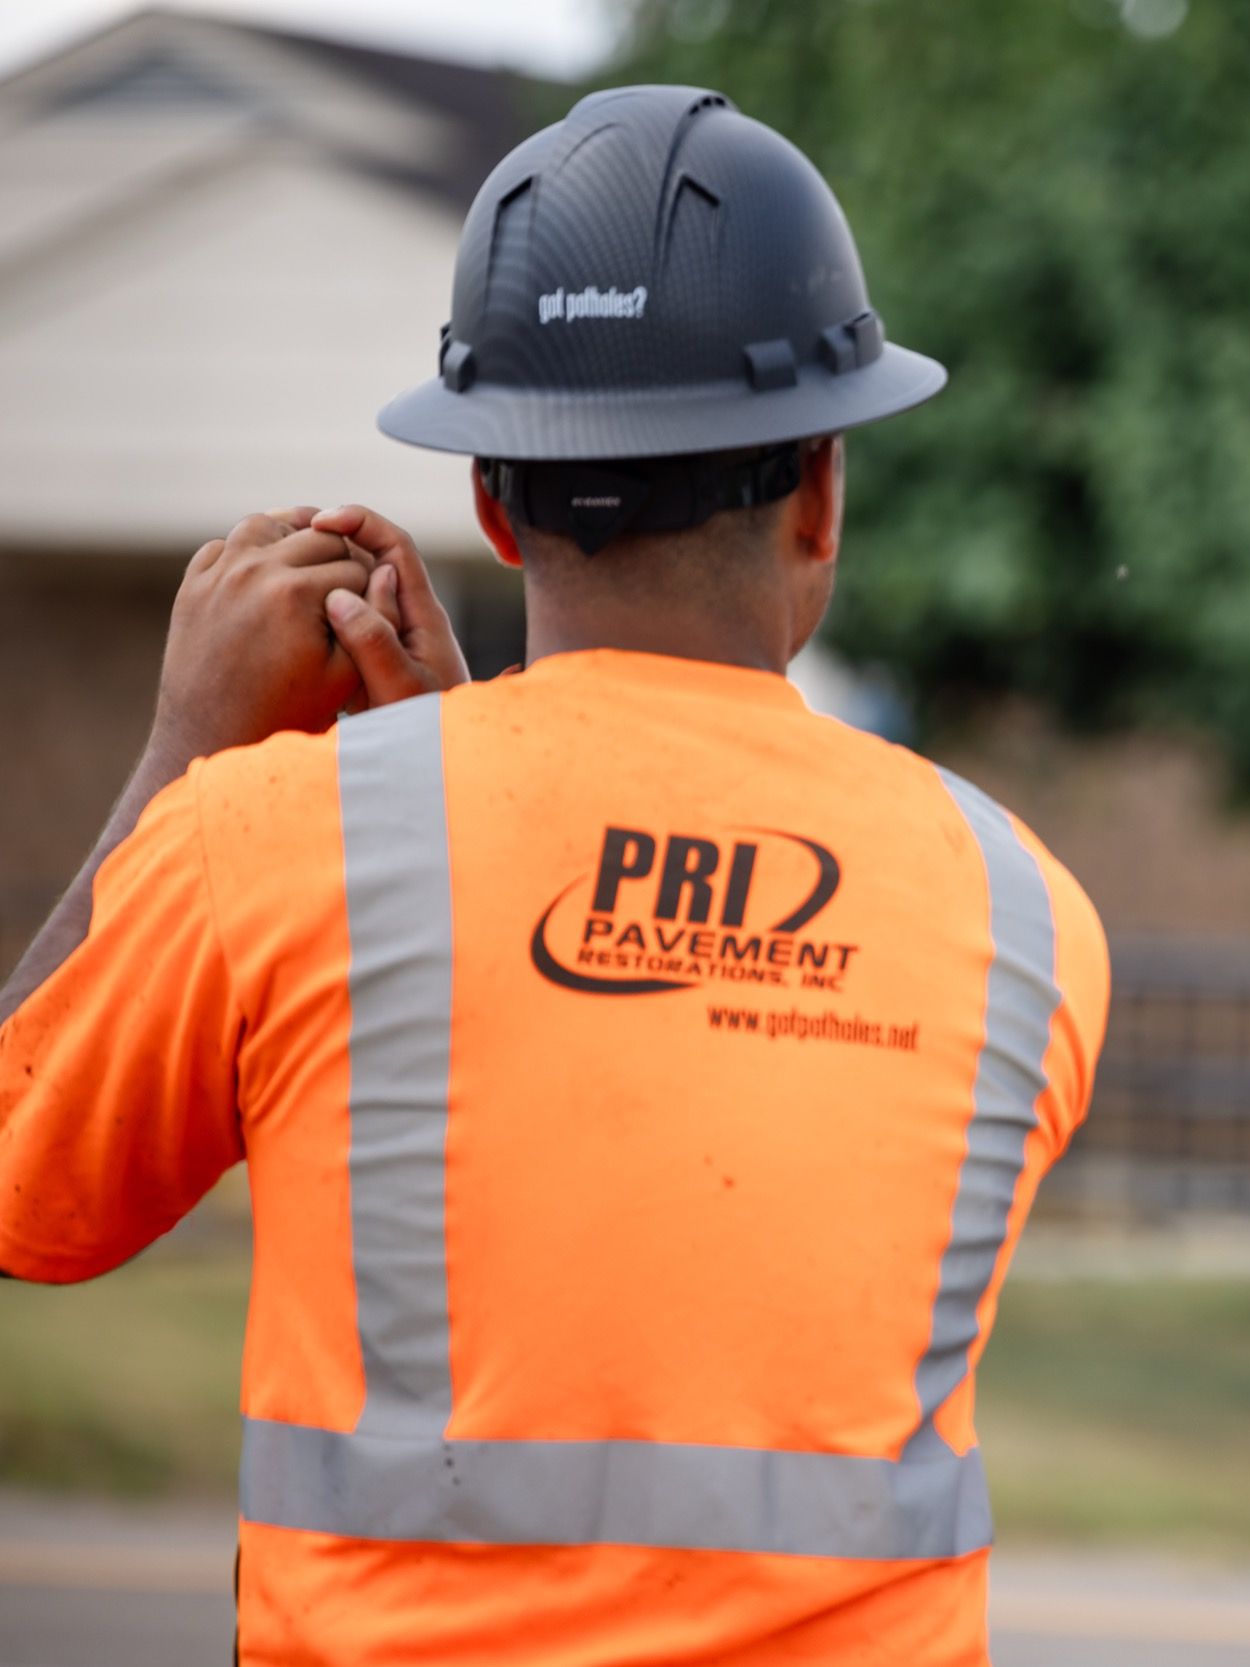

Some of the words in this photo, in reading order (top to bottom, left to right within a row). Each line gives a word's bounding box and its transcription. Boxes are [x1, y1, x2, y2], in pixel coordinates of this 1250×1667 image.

[539, 286, 565, 324] got
[566, 286, 648, 323] potholes?
[592, 826, 758, 929] PRI
[582, 918, 860, 971] PAVEMENT
